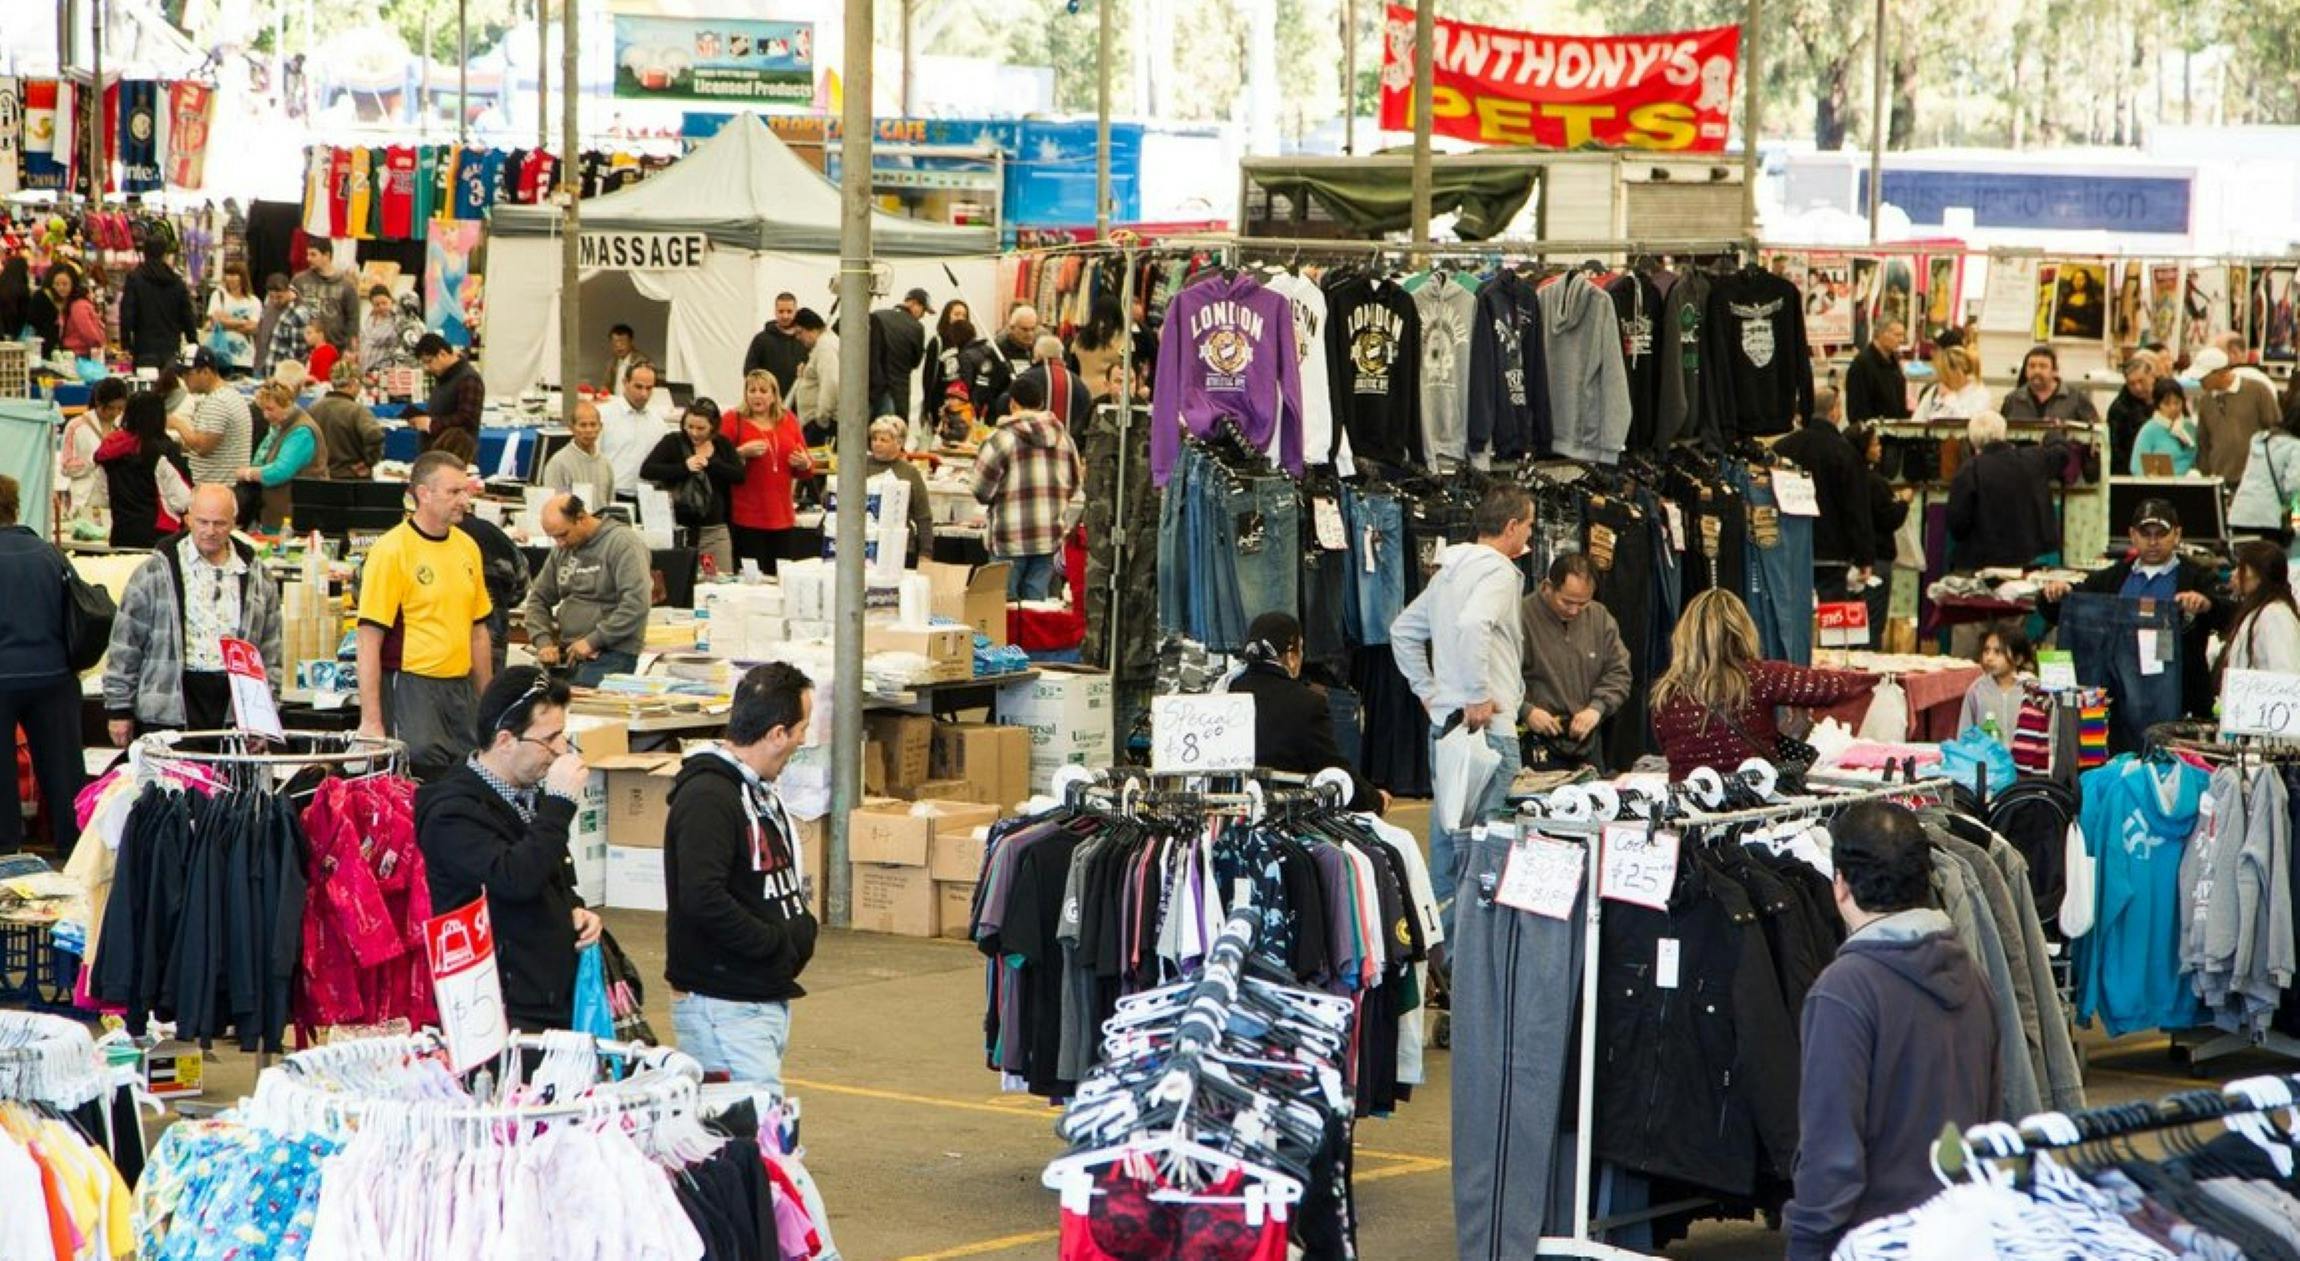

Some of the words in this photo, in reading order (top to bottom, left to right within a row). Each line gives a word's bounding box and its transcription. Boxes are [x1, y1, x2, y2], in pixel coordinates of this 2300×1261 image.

[699, 79, 753, 95] Licensed
[756, 82, 813, 97] Products
[880, 120, 927, 141] CAFE
[1406, 84, 1698, 151] PETS
[580, 235, 701, 267] MASSAGE
[1190, 301, 1264, 342] LONDON
[1347, 303, 1403, 342] LONDON
